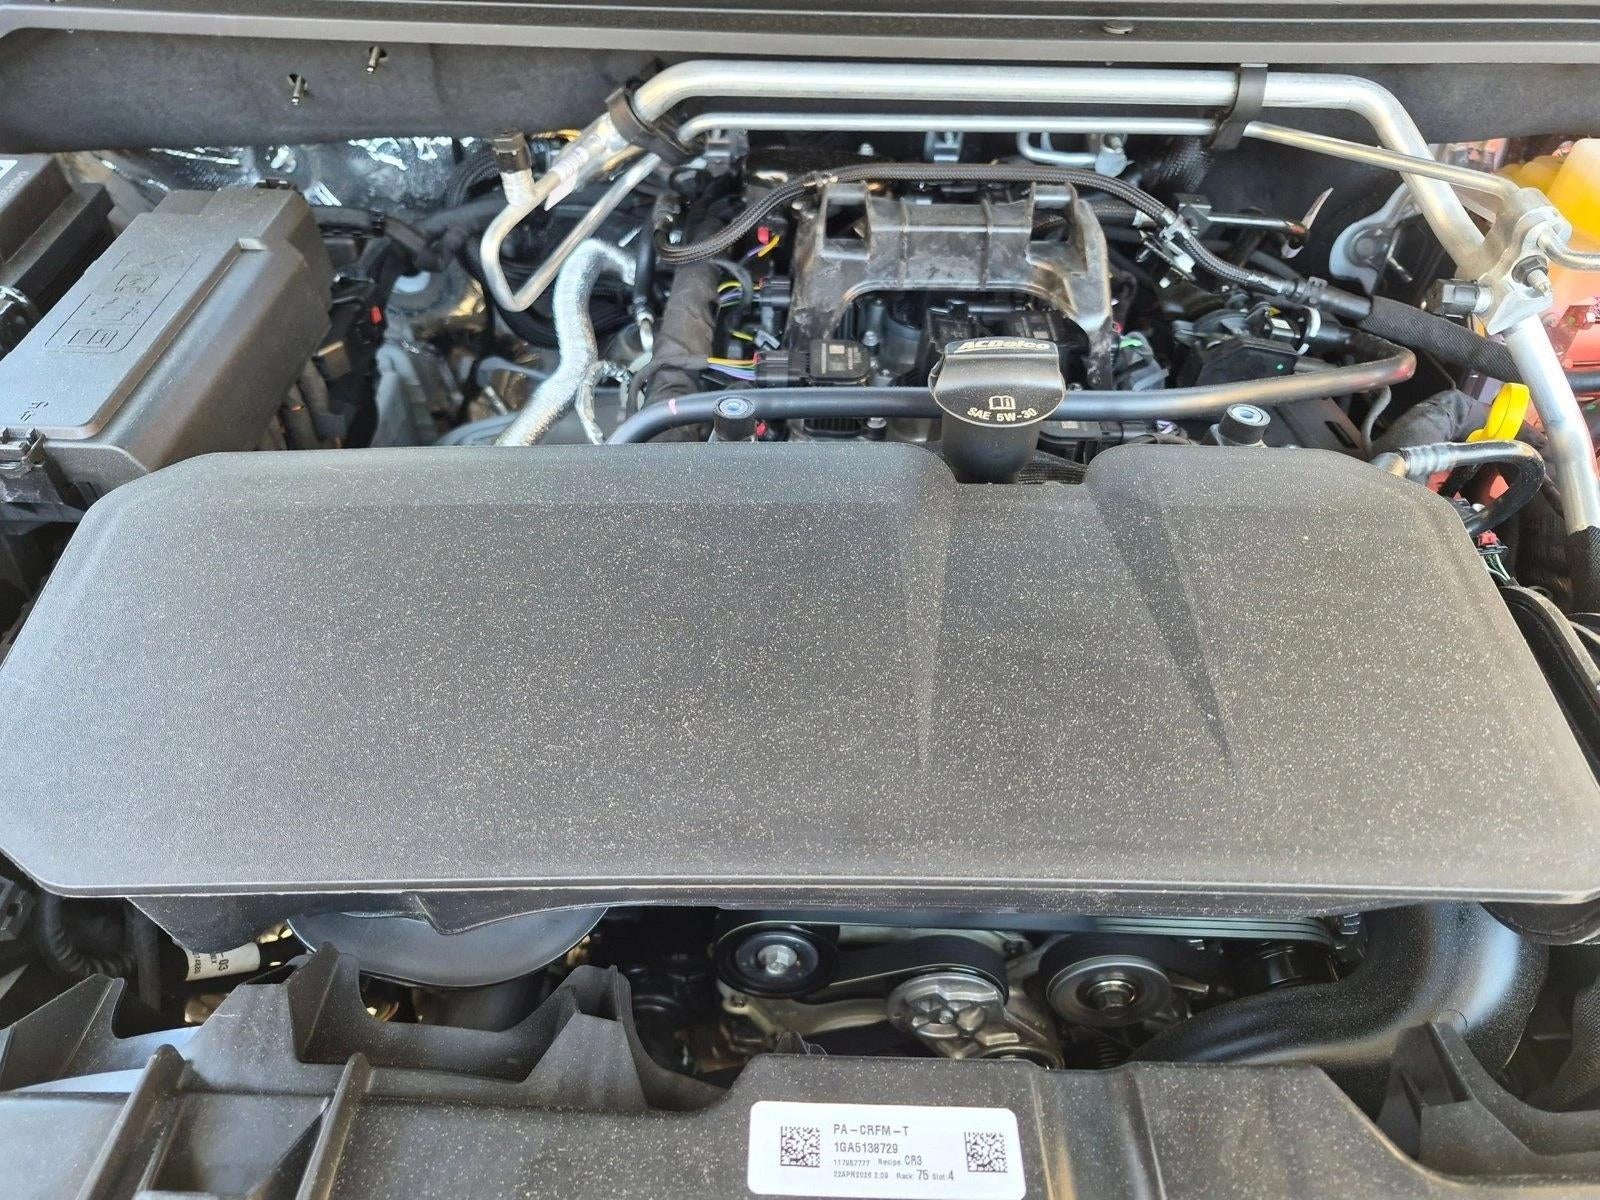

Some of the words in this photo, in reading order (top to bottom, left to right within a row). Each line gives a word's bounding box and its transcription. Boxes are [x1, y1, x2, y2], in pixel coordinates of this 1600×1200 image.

[956, 340, 1051, 351] ACDelco
[967, 407, 992, 421] SAE
[996, 407, 1038, 422] 5W-30
[834, 1142, 898, 1154] 1GA5138729
[904, 1154, 923, 1166] CR3
[916, 1169, 929, 1181] 75
